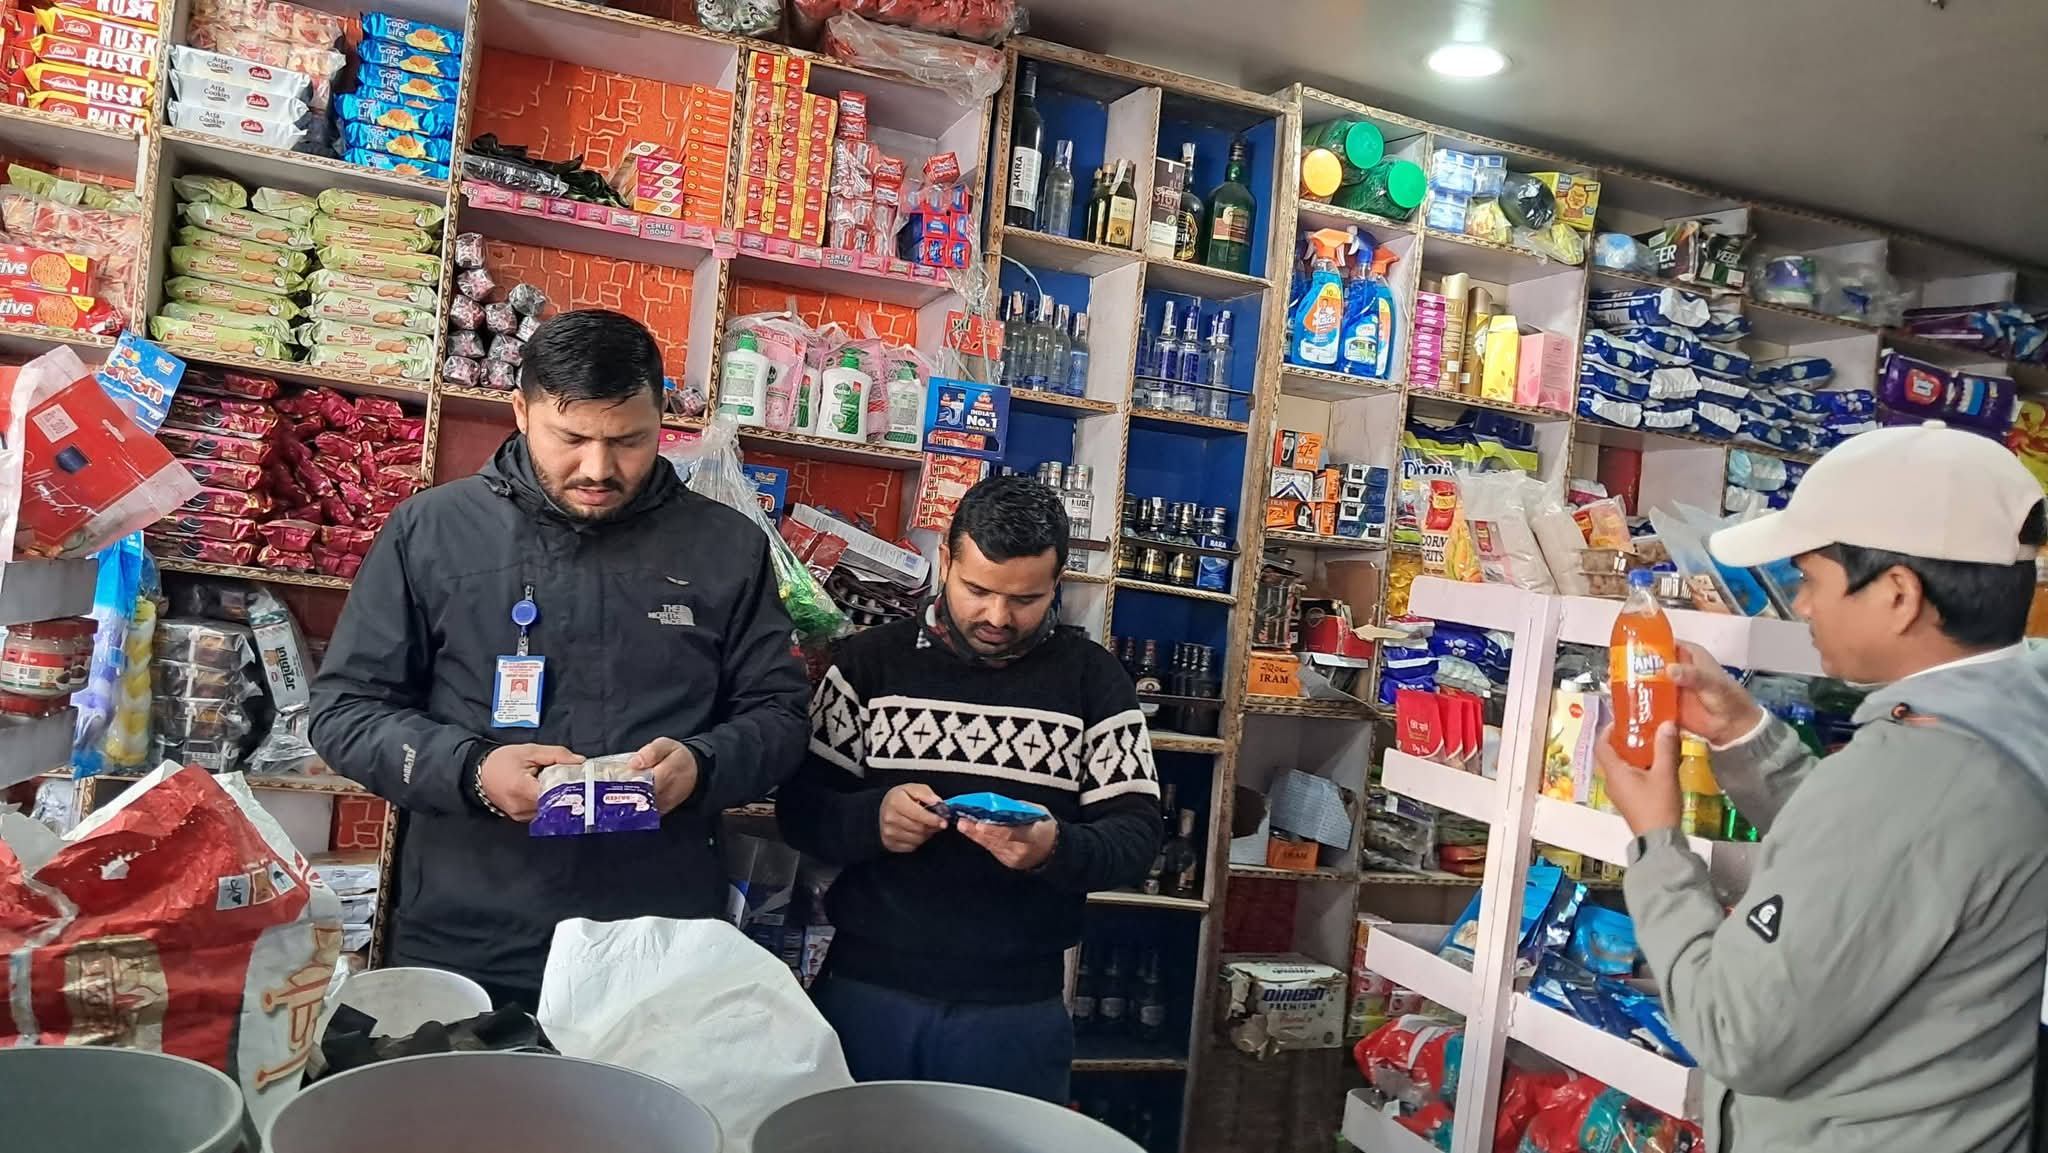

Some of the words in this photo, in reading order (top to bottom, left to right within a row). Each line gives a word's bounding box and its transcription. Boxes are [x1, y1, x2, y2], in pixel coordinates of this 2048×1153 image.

[385, 18, 410, 31] Good
[387, 27, 405, 38] Life
[100, 25, 158, 57] RUSK
[378, 45, 404, 57] Good
[85, 47, 147, 76] RUSK
[381, 54, 399, 65] Life
[207, 61, 233, 72] Cookies
[378, 69, 403, 81] Good
[381, 78, 399, 88] Life
[85, 79, 147, 107] RUSK
[203, 88, 230, 100] Cookies
[87, 108, 146, 136] RUSK
[199, 115, 225, 126] Cookies
[1014, 156, 1024, 188] AKIRA
[645, 223, 675, 232] CENTER
[966, 415, 998, 428] No.1
[937, 437, 950, 446] HIT
[935, 452, 947, 461] HIT
[933, 466, 945, 475] HIT
[926, 491, 938, 500] HIT
[922, 504, 935, 513] HIT
[920, 517, 932, 526] HIT
[1424, 551, 1444, 563] RITS
[1259, 674, 1289, 684] IRAM
[1269, 1002, 1316, 1011] PREMIUM
